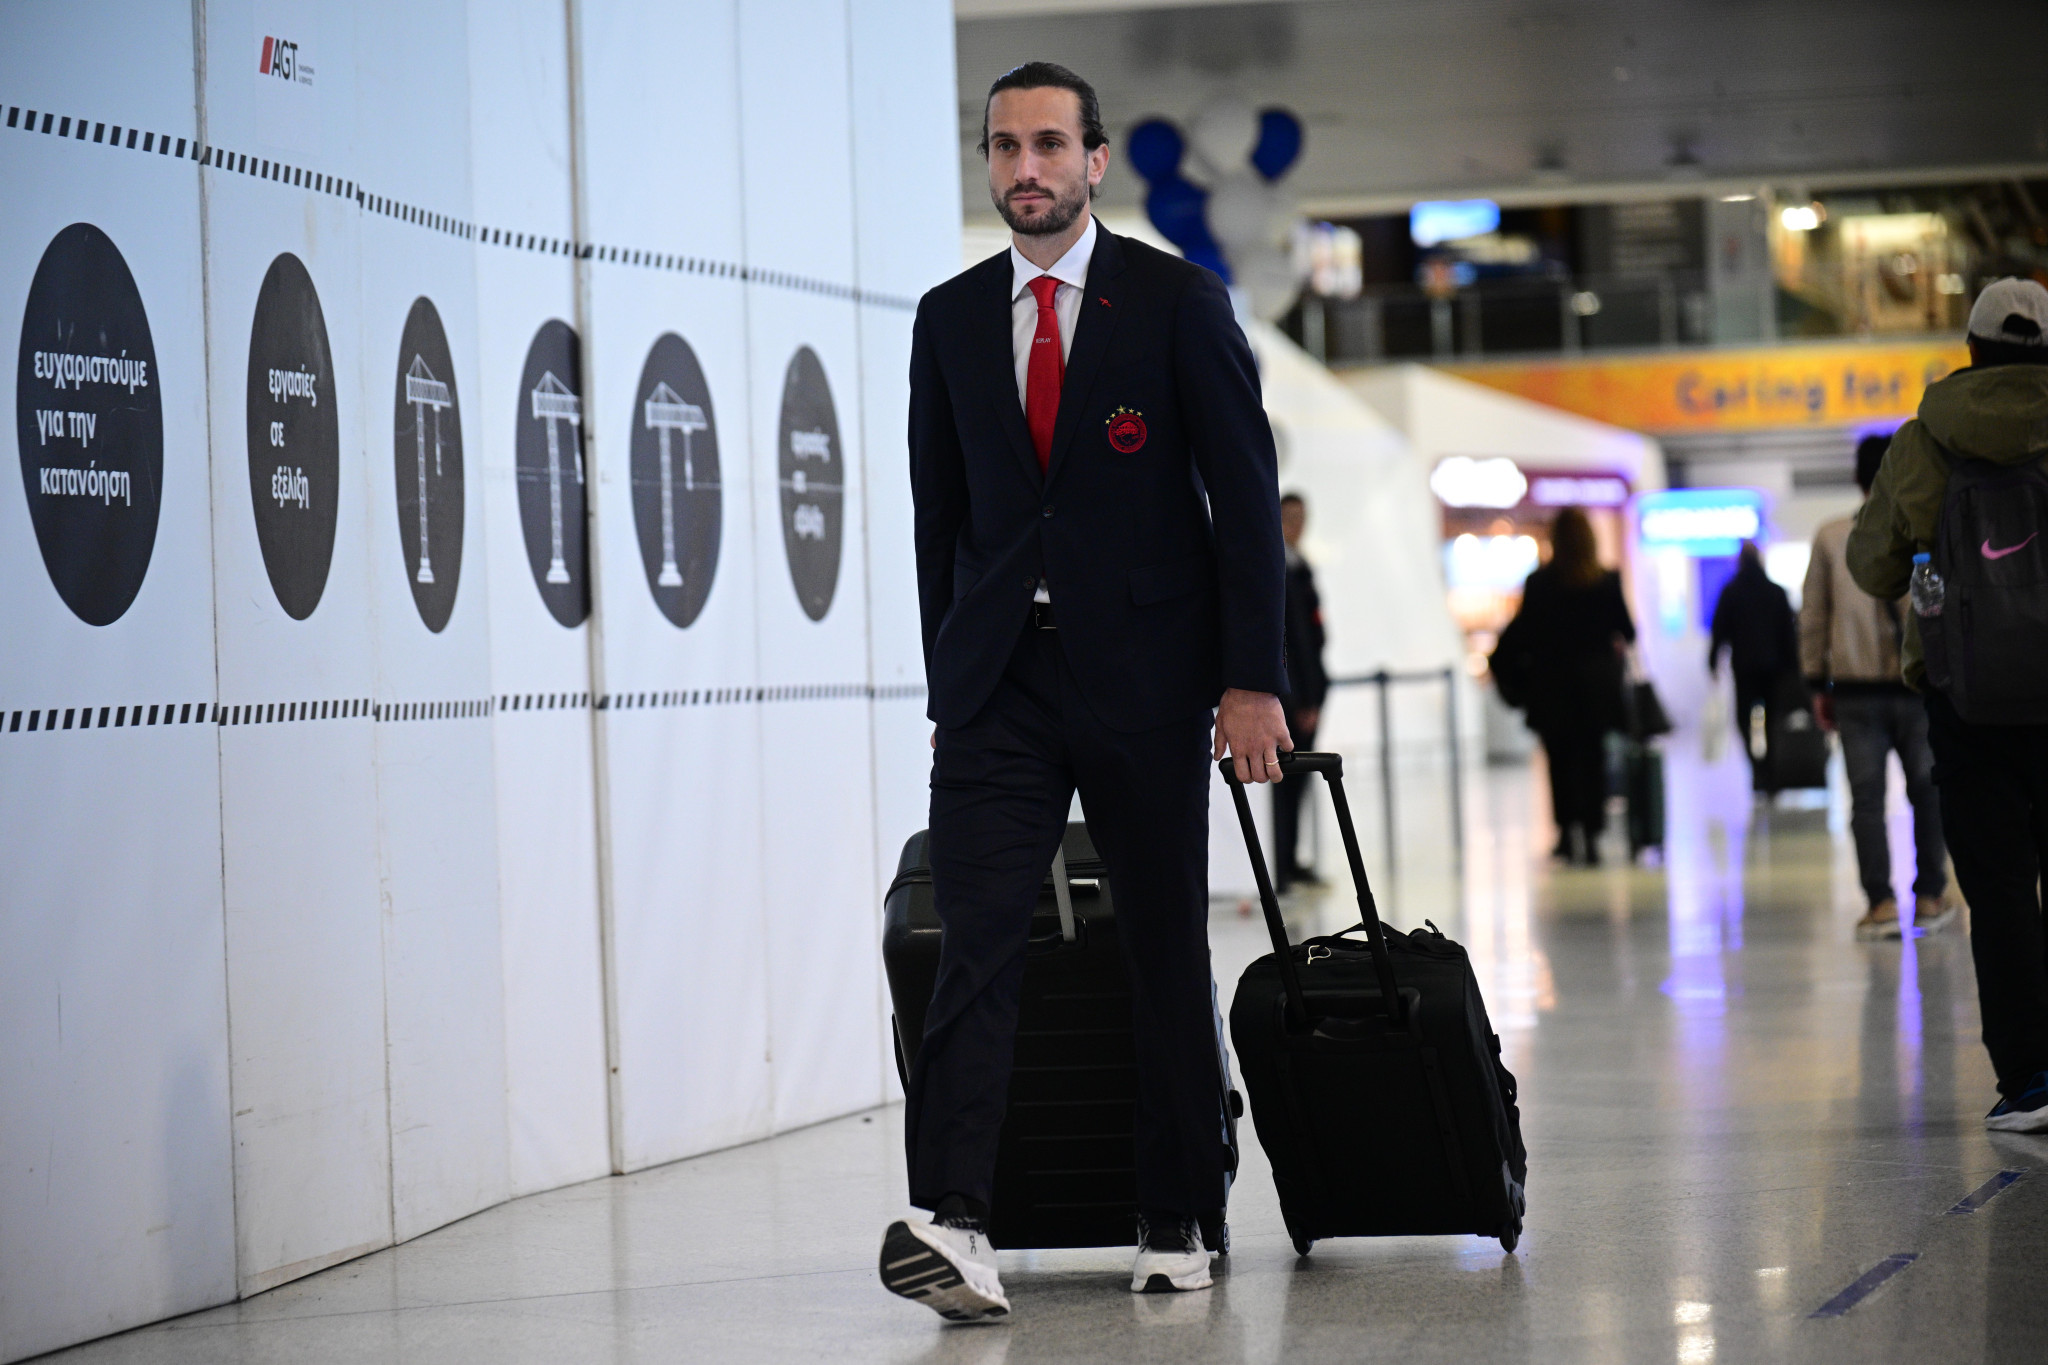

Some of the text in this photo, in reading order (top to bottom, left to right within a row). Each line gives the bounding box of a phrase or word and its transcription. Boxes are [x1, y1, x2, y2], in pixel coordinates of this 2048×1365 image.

[271, 38, 298, 82] AGT
[34, 349, 148, 395] ευχαριστούμε
[268, 363, 317, 407] εργασίες
[36, 409, 97, 448] για την
[270, 421, 285, 448] σε
[39, 460, 131, 507] κατανόηση
[271, 465, 310, 510] εξέλιξη
